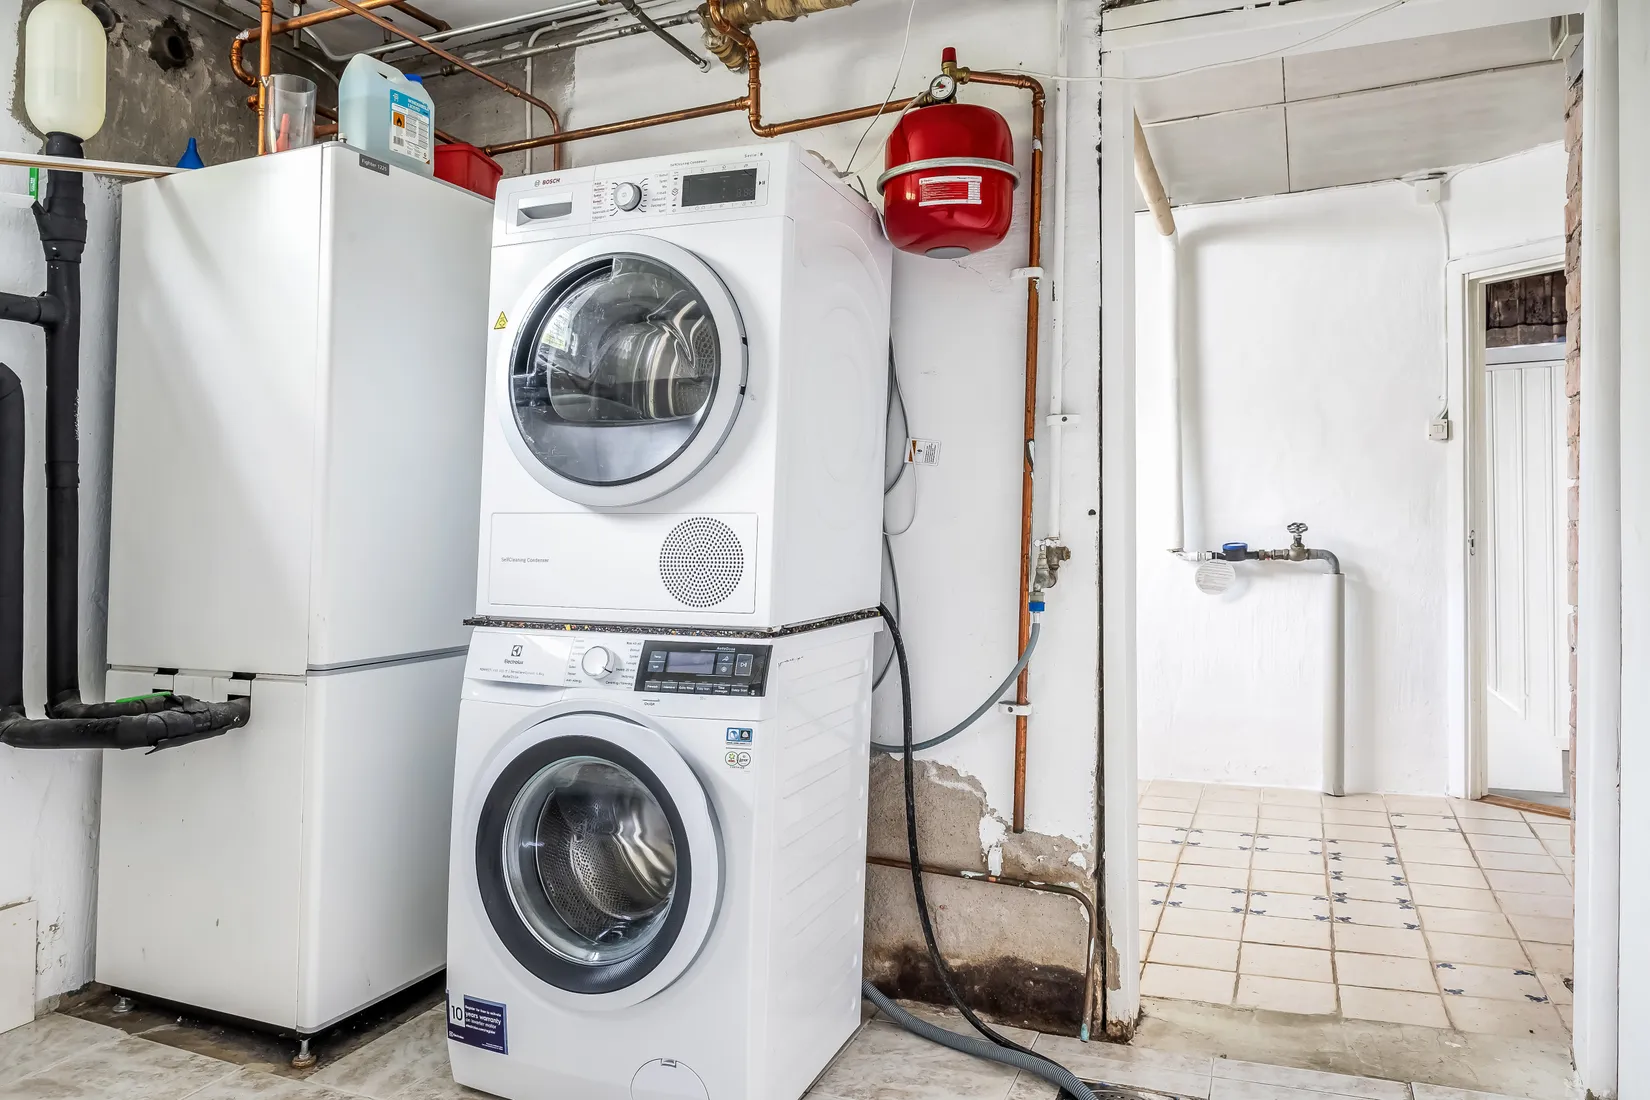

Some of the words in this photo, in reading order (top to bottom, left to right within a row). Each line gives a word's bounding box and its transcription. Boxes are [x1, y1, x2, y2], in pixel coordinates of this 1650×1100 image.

[361, 158, 376, 168] Fighter
[451, 1005, 463, 1021] 10
[465, 1011, 478, 1019] years
[479, 1015, 501, 1025] warranty
